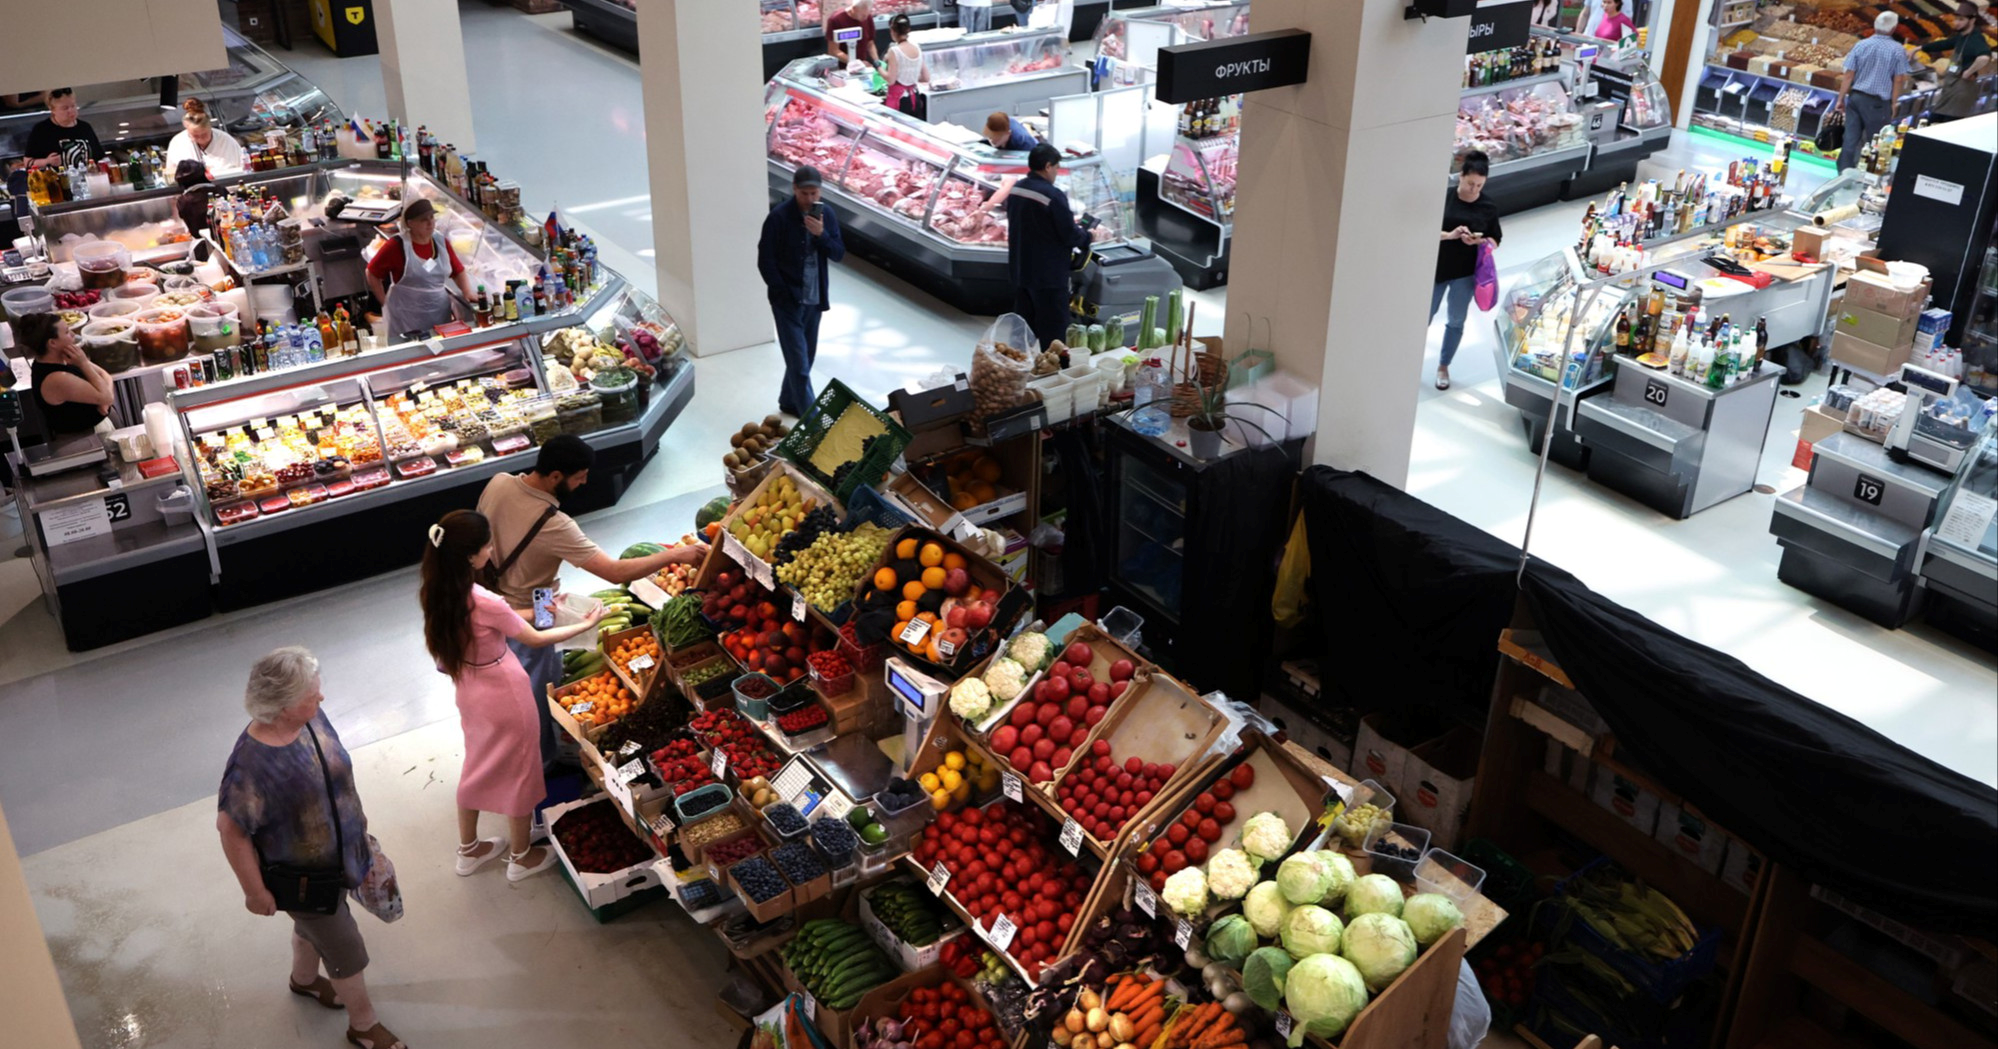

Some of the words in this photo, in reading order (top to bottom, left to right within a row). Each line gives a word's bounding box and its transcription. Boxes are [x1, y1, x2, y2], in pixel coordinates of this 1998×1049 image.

[1469, 22, 1495, 39] ЫРЫ
[1215, 57, 1271, 79] ФРУКТЫ
[1646, 385, 1666, 404] 20
[1860, 482, 1879, 500] 19
